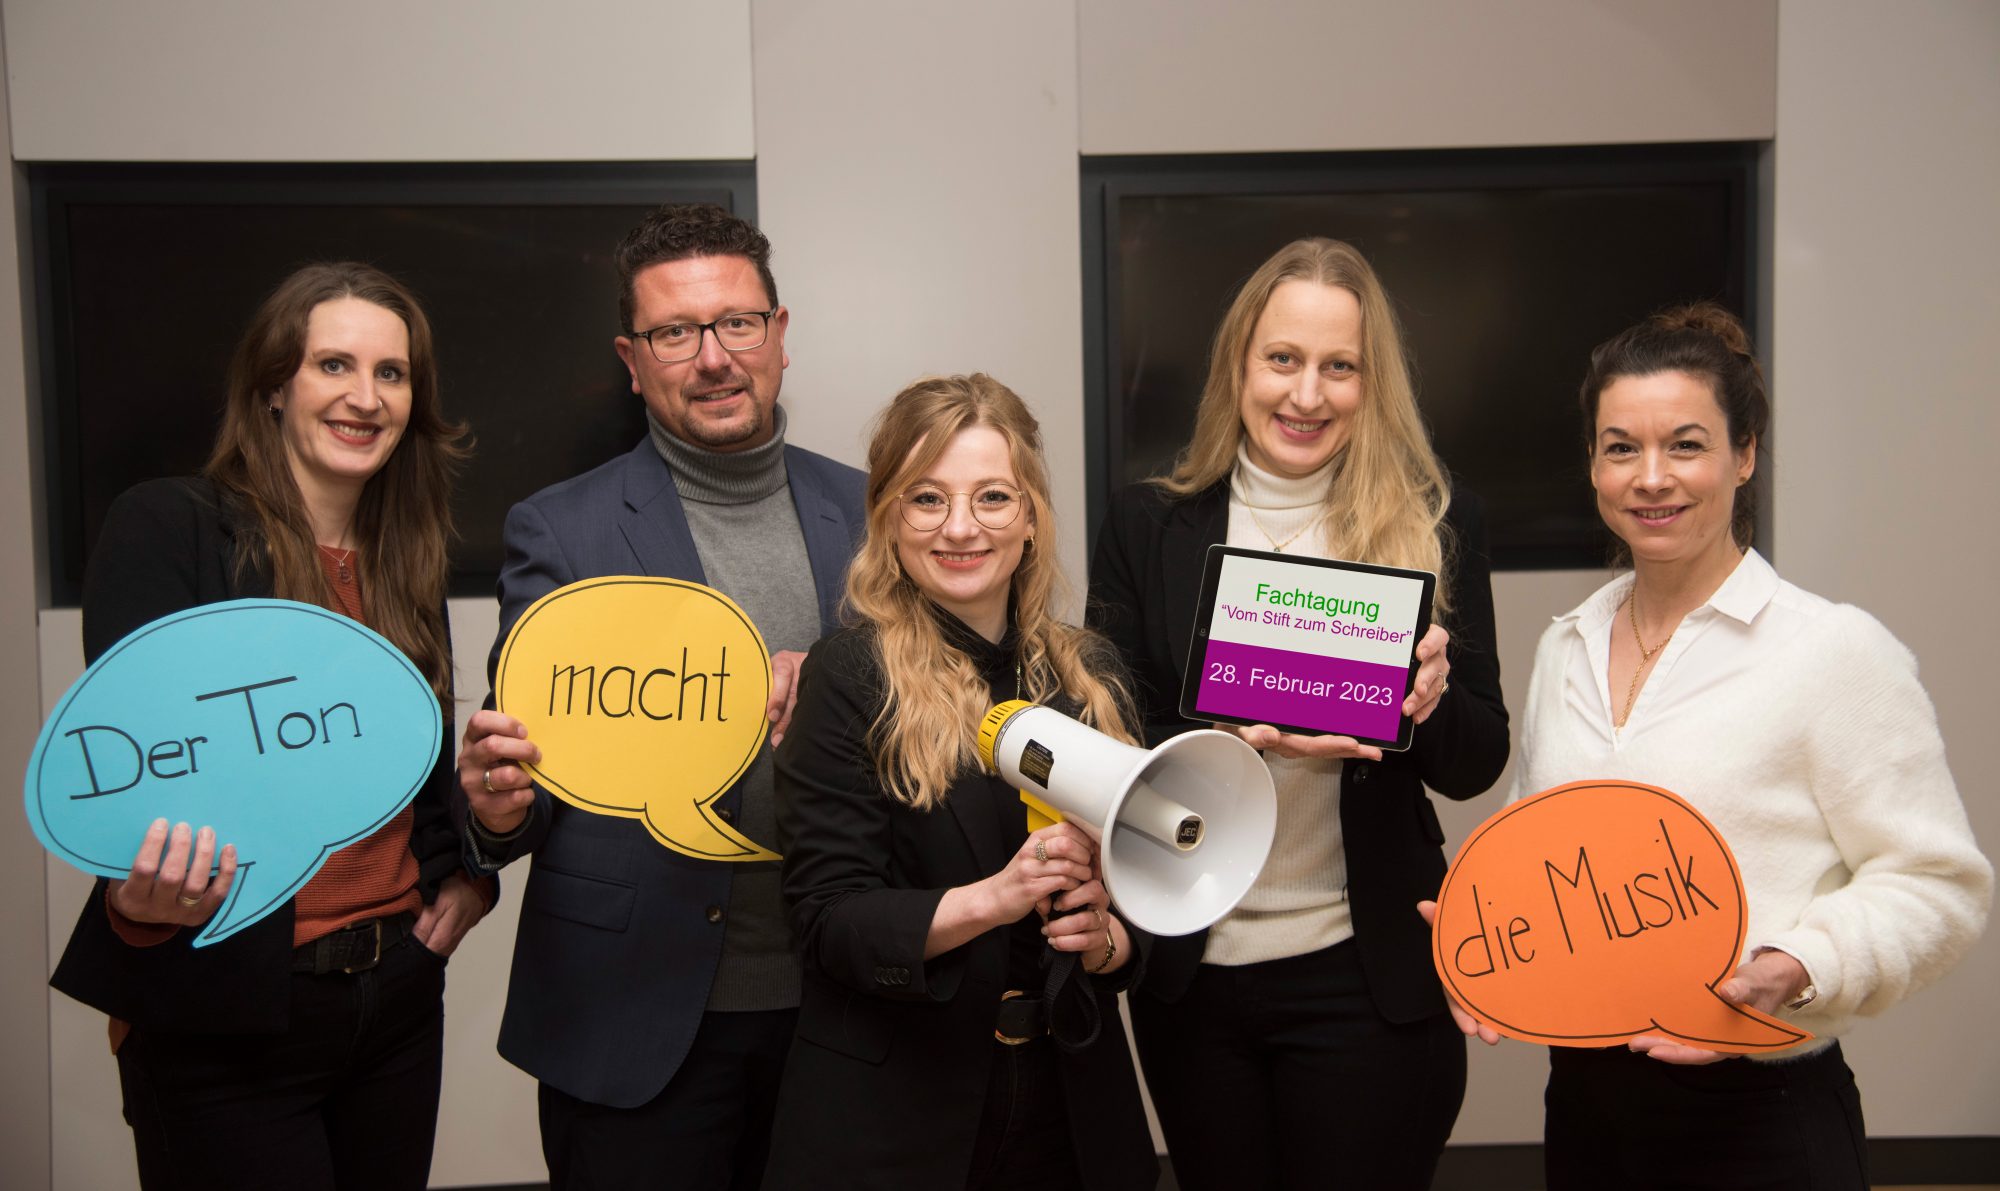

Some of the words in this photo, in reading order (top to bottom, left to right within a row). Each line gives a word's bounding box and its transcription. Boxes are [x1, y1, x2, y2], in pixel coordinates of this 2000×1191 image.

[1255, 583, 1380, 623] Fachtagung
[1262, 610, 1290, 627] Stift
[1294, 617, 1326, 632] zum
[549, 646, 730, 722] macht
[1208, 662, 1241, 685] 28.
[1249, 667, 1334, 698] Februar
[1339, 681, 1393, 706] 2023
[65, 725, 208, 800] Der
[195, 675, 362, 755] Ton
[1455, 884, 1535, 977] die
[1544, 818, 1719, 955] Musik
